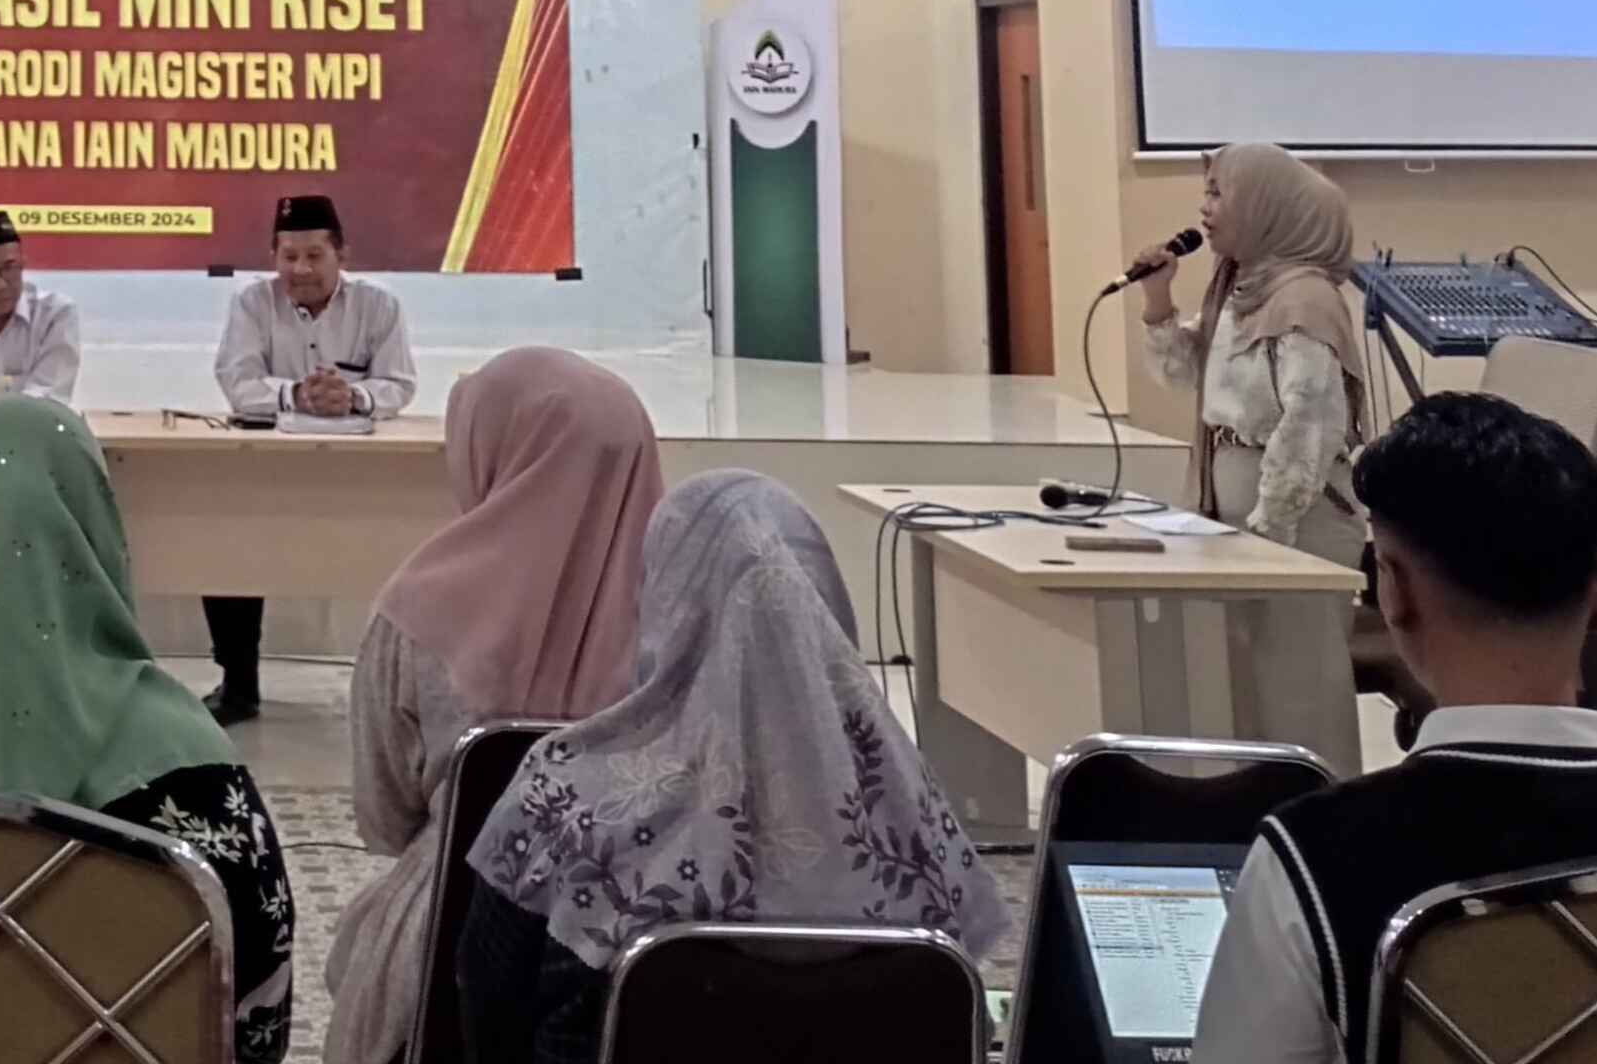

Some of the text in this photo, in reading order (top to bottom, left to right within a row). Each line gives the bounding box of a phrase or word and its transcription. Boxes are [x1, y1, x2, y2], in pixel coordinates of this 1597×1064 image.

[94, 50, 295, 100] MAGISTER
[305, 52, 382, 101] MPI
[73, 120, 154, 169] IAIN
[166, 121, 337, 171] MADURA
[18, 211, 41, 225] 09
[47, 211, 146, 225] DESEMBER
[151, 212, 196, 226] 2024
